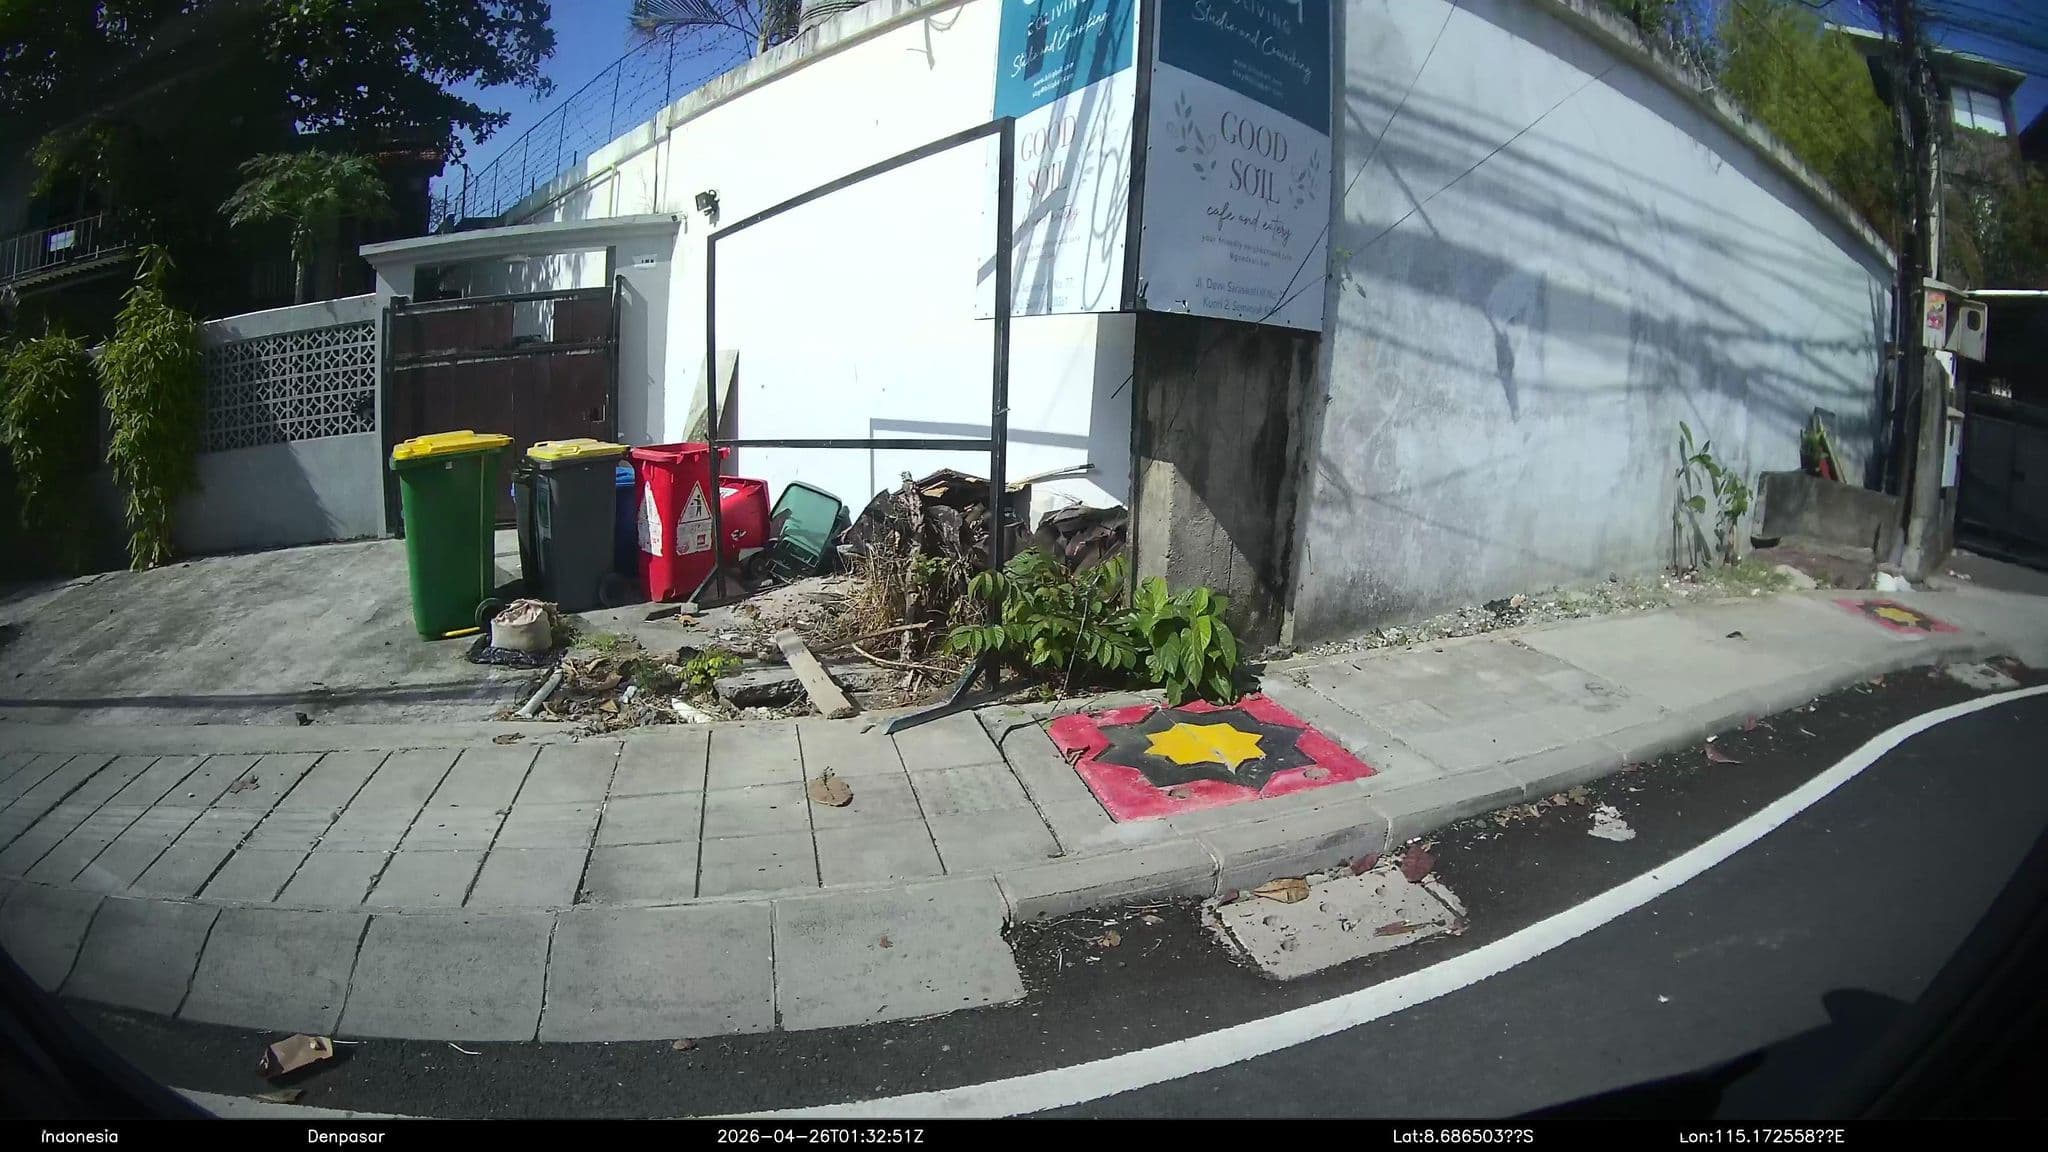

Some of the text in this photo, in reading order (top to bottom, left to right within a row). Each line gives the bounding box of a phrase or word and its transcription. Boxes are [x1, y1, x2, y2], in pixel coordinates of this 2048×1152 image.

[1239, 29, 1261, 49] and
[1021, 115, 1076, 162] GOOD
[1221, 111, 1288, 163] GOOD
[1229, 158, 1281, 205] SOIL
[1206, 201, 1293, 248] cafe and eatery
